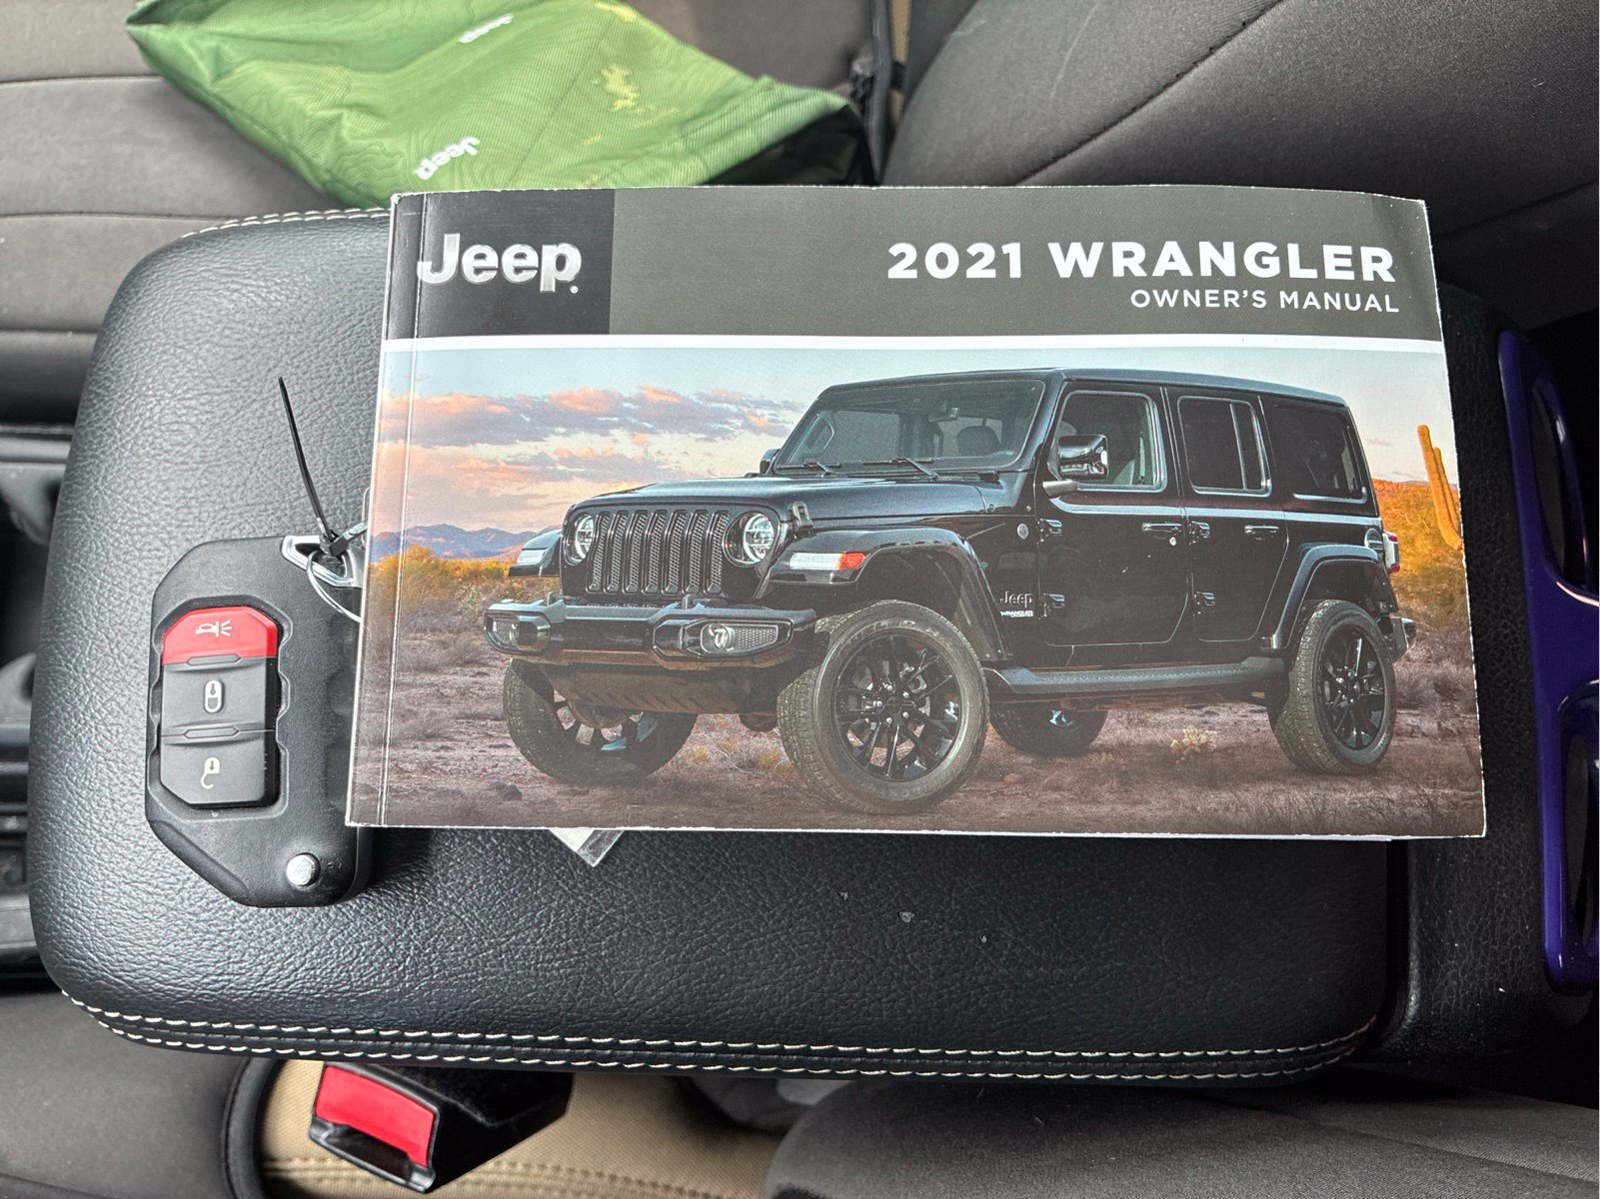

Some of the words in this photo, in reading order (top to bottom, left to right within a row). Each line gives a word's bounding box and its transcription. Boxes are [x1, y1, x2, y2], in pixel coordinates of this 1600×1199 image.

[415, 136, 481, 181] Jeep
[416, 232, 582, 293] Jeep
[887, 242, 1022, 279] 2021
[1048, 240, 1396, 282] WRANGLER
[1130, 289, 1267, 309] OWNER'S
[1279, 290, 1399, 313] MANUAL
[1000, 590, 1032, 609] Jeep
